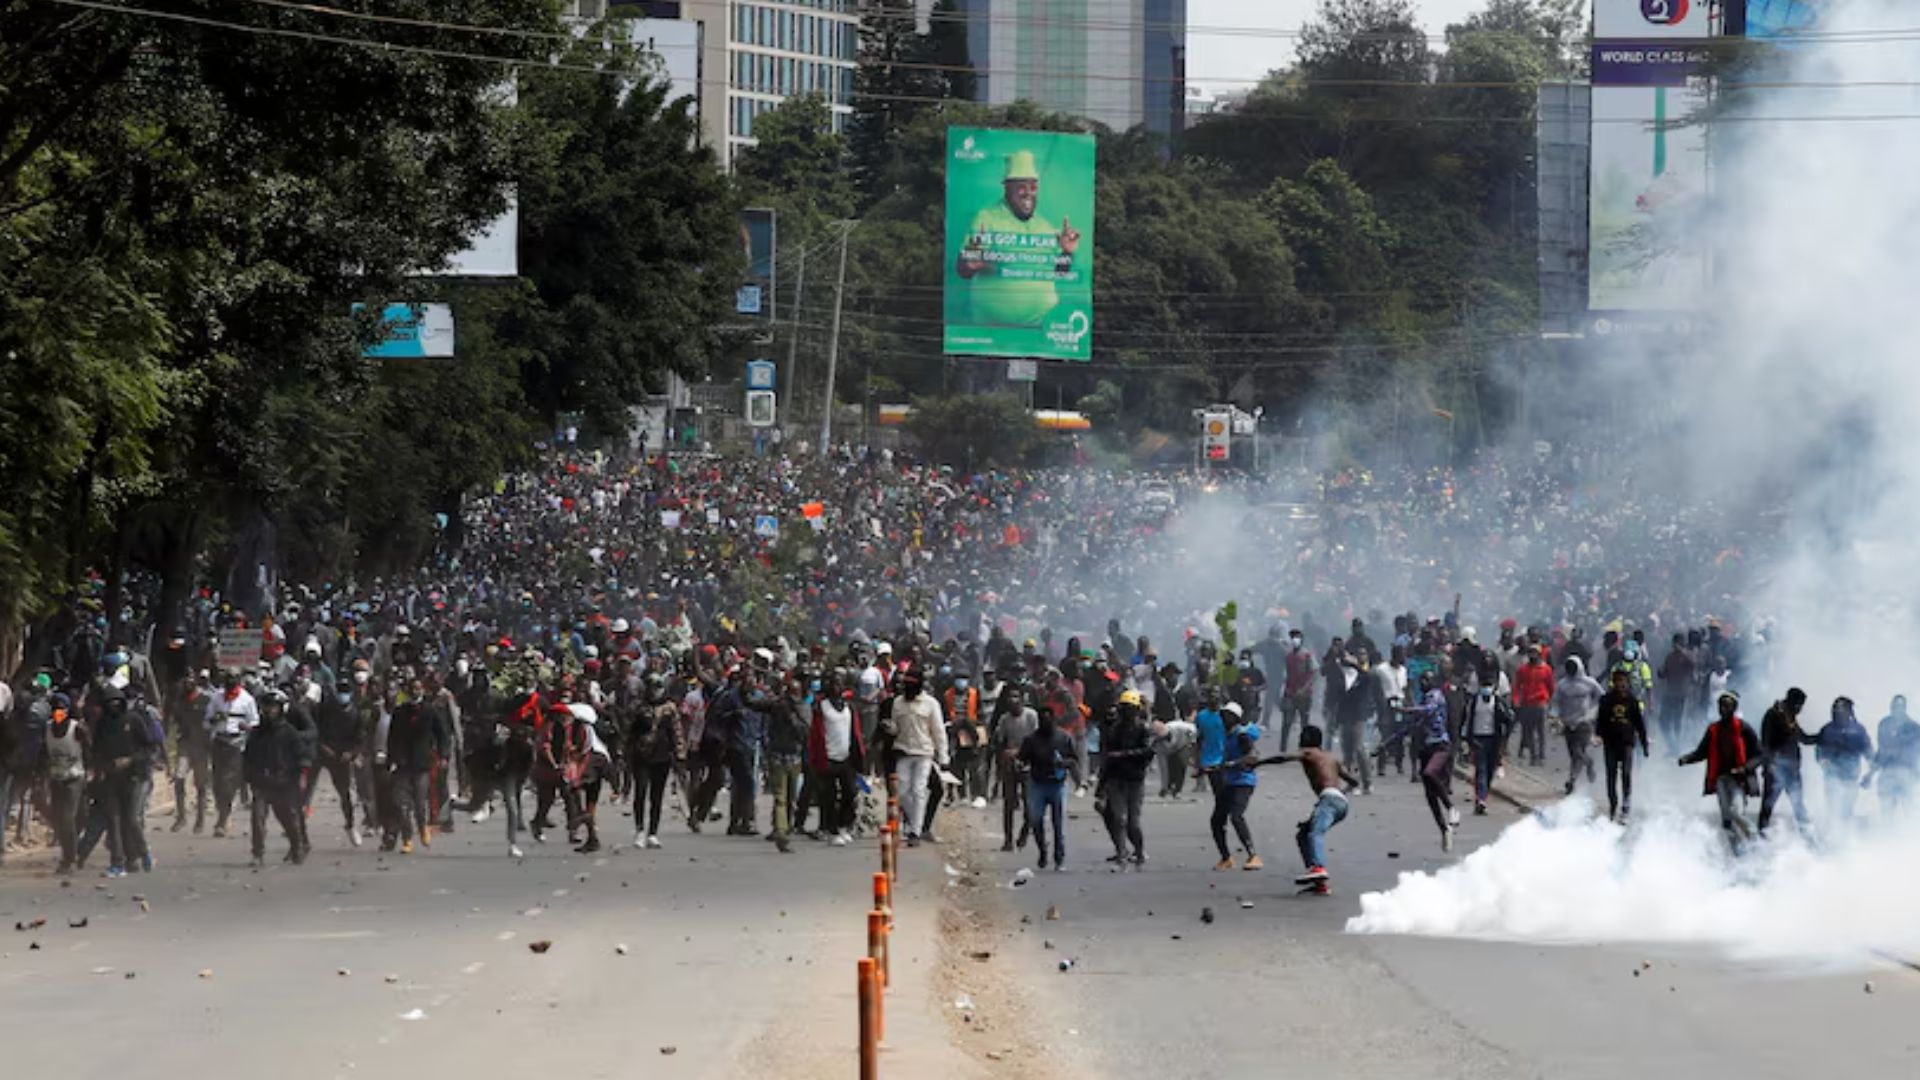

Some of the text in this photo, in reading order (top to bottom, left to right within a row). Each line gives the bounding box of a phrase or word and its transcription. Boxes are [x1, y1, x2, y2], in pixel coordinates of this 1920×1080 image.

[1601, 51, 1644, 62] WORLD
[1647, 51, 1684, 62] CLASS
[994, 233, 1017, 245] GOT
[1020, 234, 1028, 245] A
